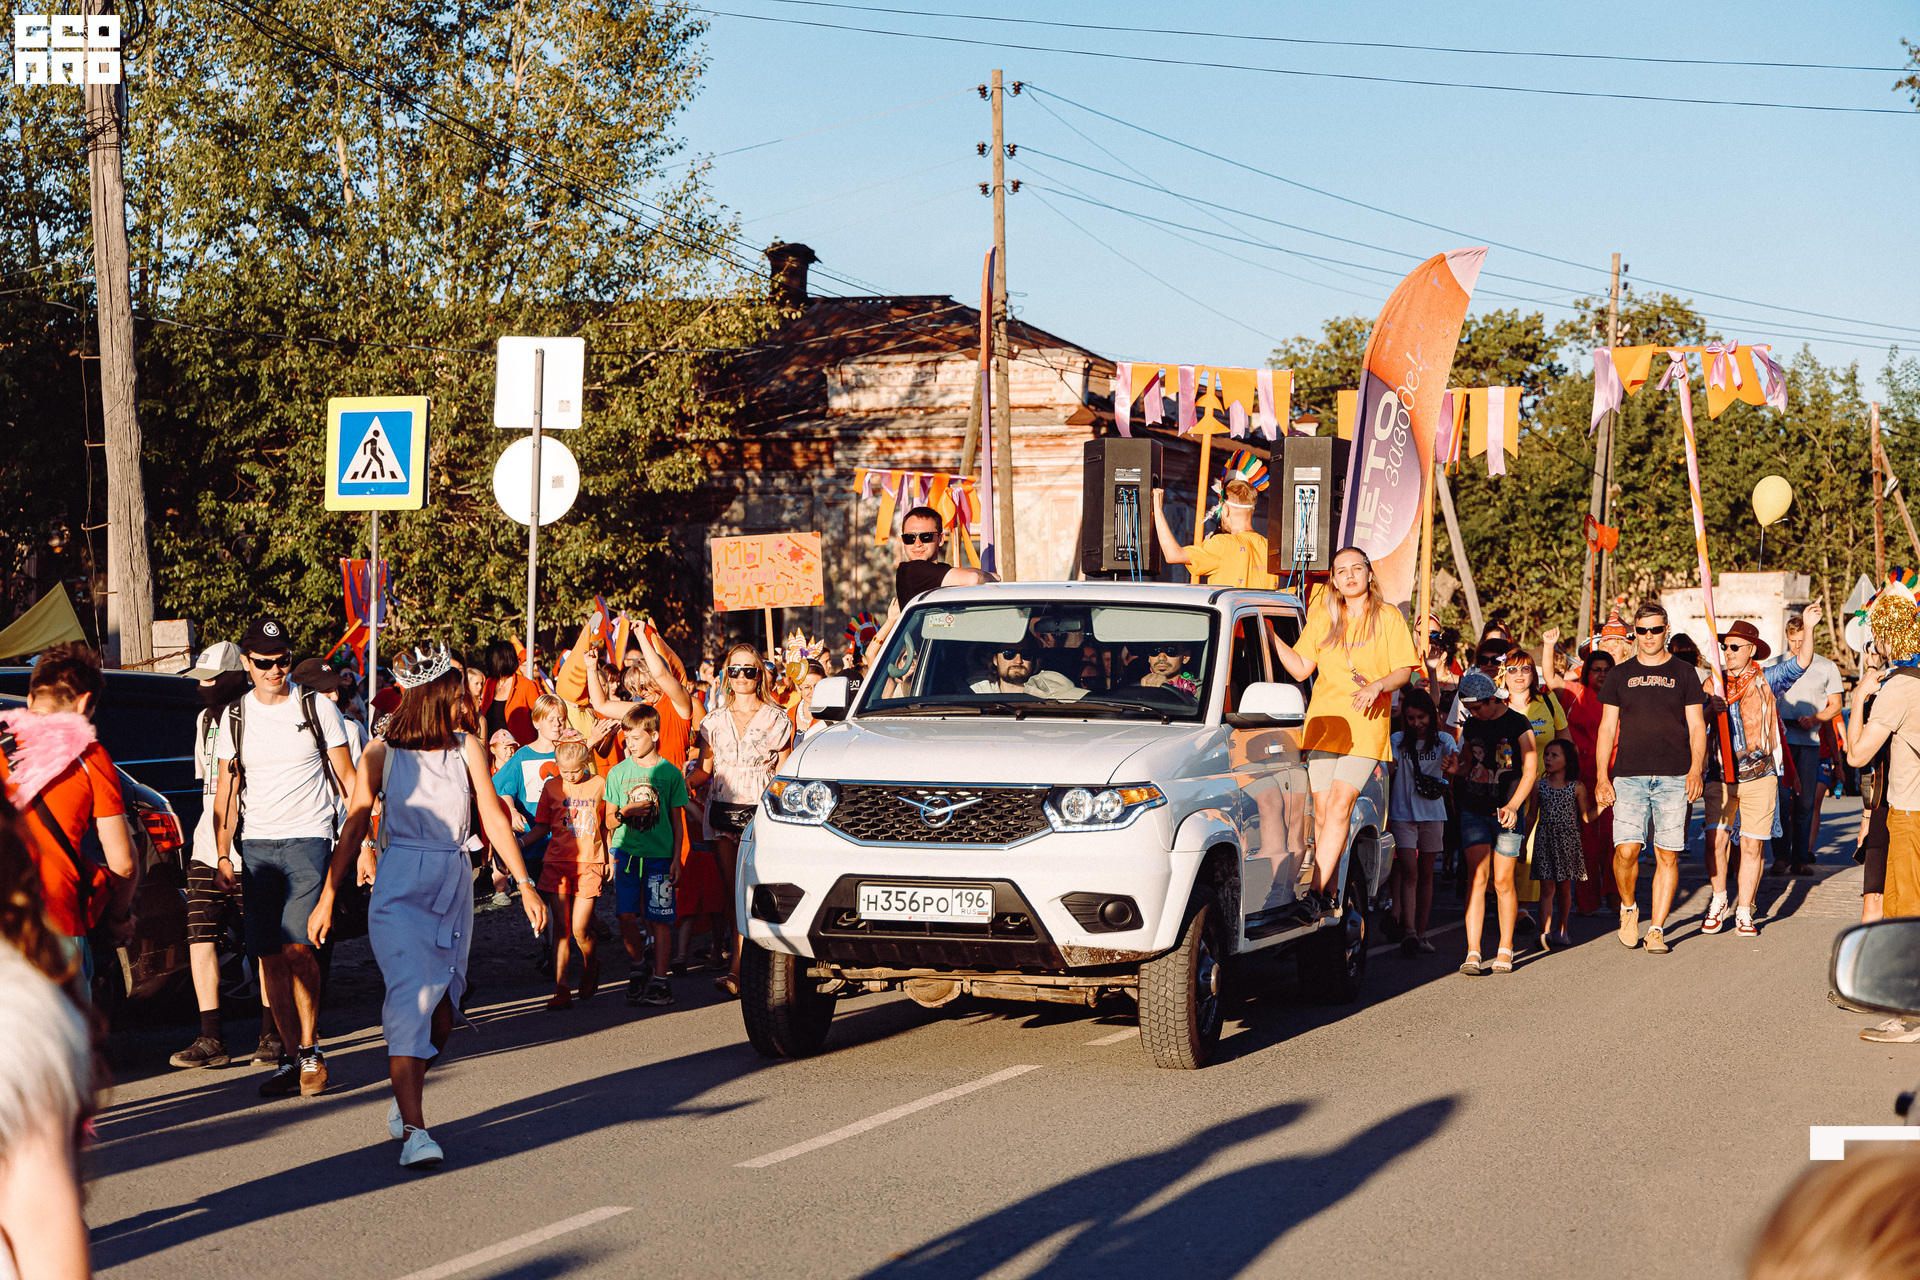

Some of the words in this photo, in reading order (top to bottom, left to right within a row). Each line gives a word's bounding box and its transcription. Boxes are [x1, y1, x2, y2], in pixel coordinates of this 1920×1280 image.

[1372, 501, 1394, 545] на
[725, 542, 763, 566] МЫ
[726, 574, 735, 583] и
[741, 569, 783, 584] есть
[731, 582, 805, 605] ЗАВОД
[954, 891, 985, 908] 196
